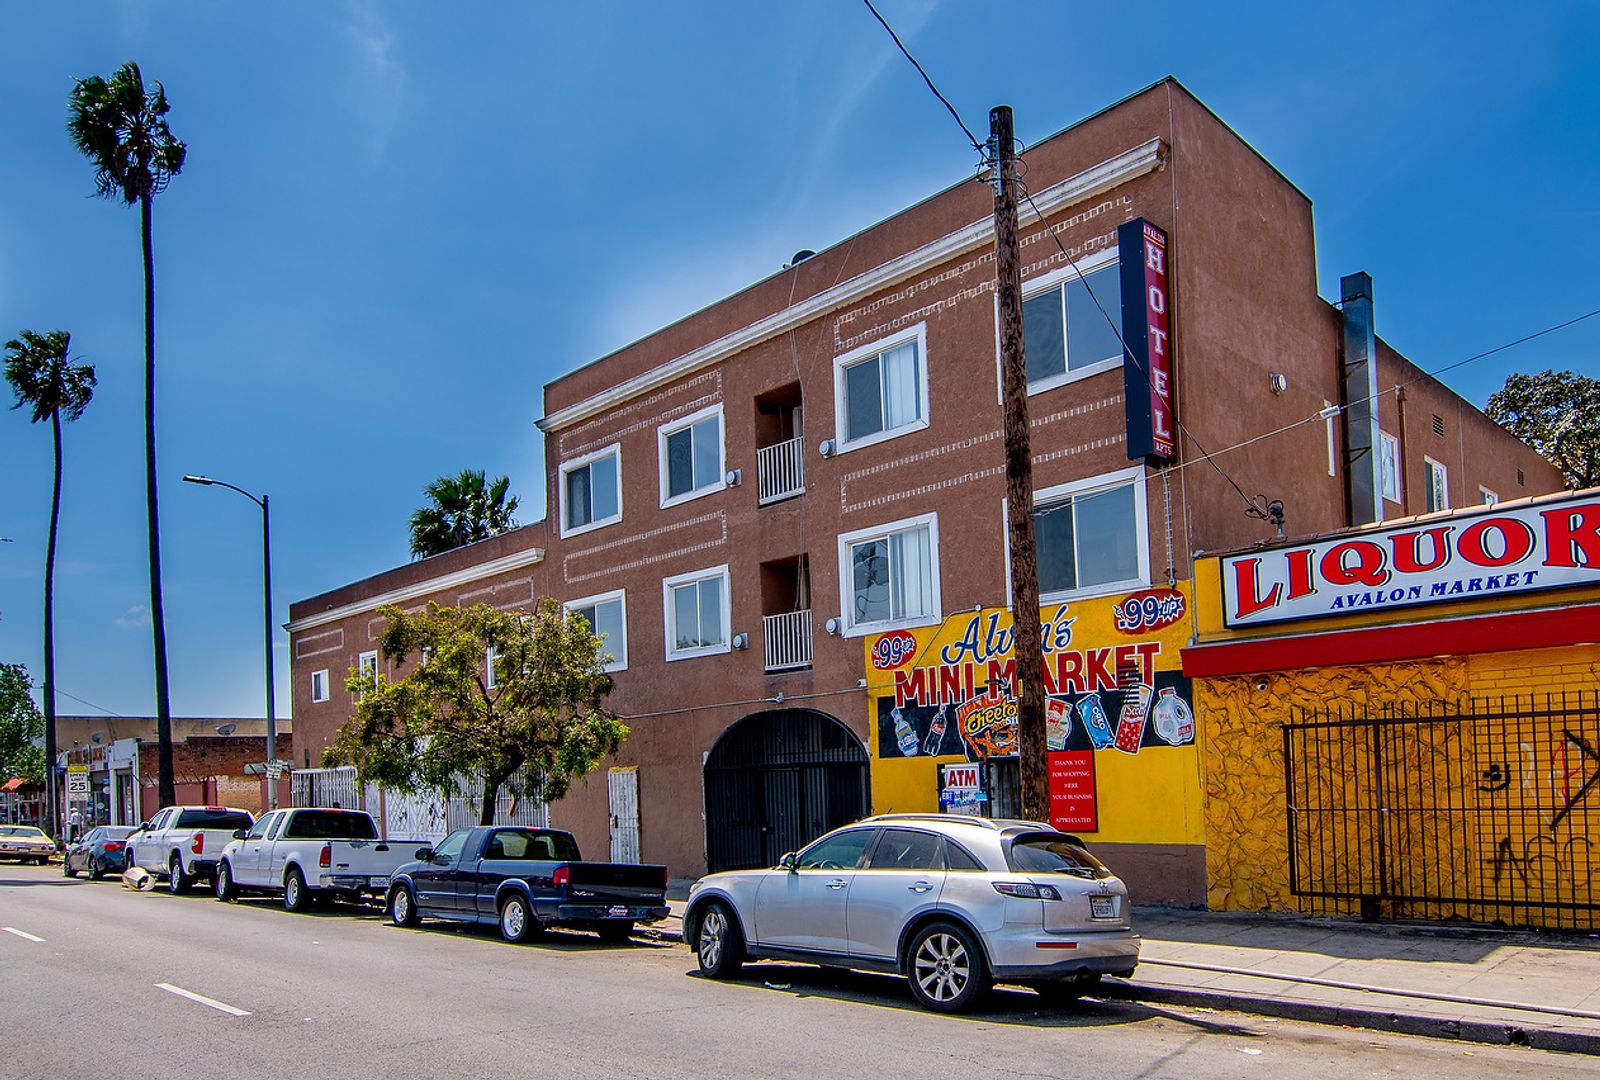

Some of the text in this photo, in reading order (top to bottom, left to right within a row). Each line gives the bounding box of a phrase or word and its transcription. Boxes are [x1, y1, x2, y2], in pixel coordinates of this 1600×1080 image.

[1146, 241, 1170, 440] HOTEL
[1232, 503, 1600, 619] LIQUOR
[1330, 570, 1539, 609] AVALON MARKET
[941, 605, 1078, 664] Alvn's
[893, 661, 976, 708] MINI
[967, 699, 1018, 733] Cheeto
[70, 782, 86, 791] 25
[948, 769, 977, 787] ATM
